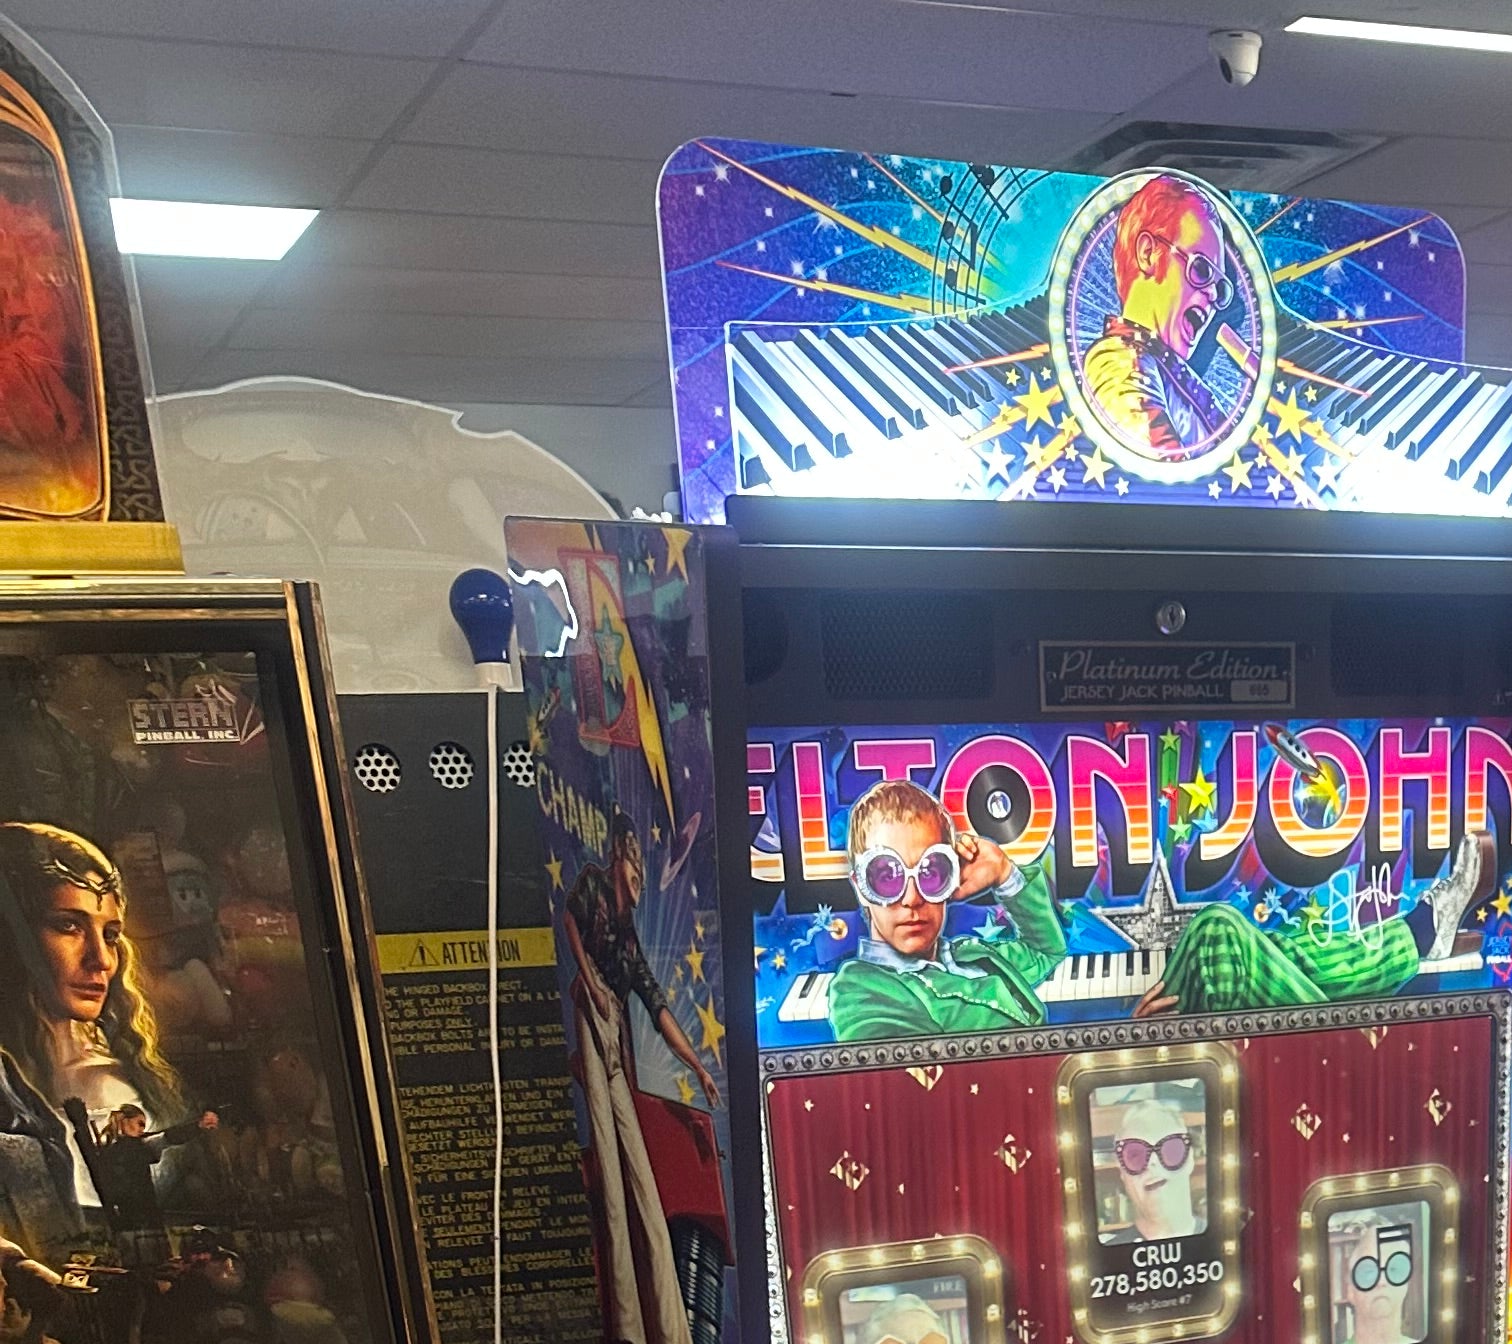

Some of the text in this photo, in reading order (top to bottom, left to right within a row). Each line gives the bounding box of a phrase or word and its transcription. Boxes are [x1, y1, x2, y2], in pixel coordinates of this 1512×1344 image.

[1059, 650, 1278, 681] Platinum Edition
[1063, 682, 1224, 702] JERSEY JACK PINBALL
[133, 702, 234, 729] STERN
[442, 938, 522, 964] ATTENION
[1132, 1241, 1182, 1269] CRW
[1090, 1260, 1224, 1299] 278,580,350
